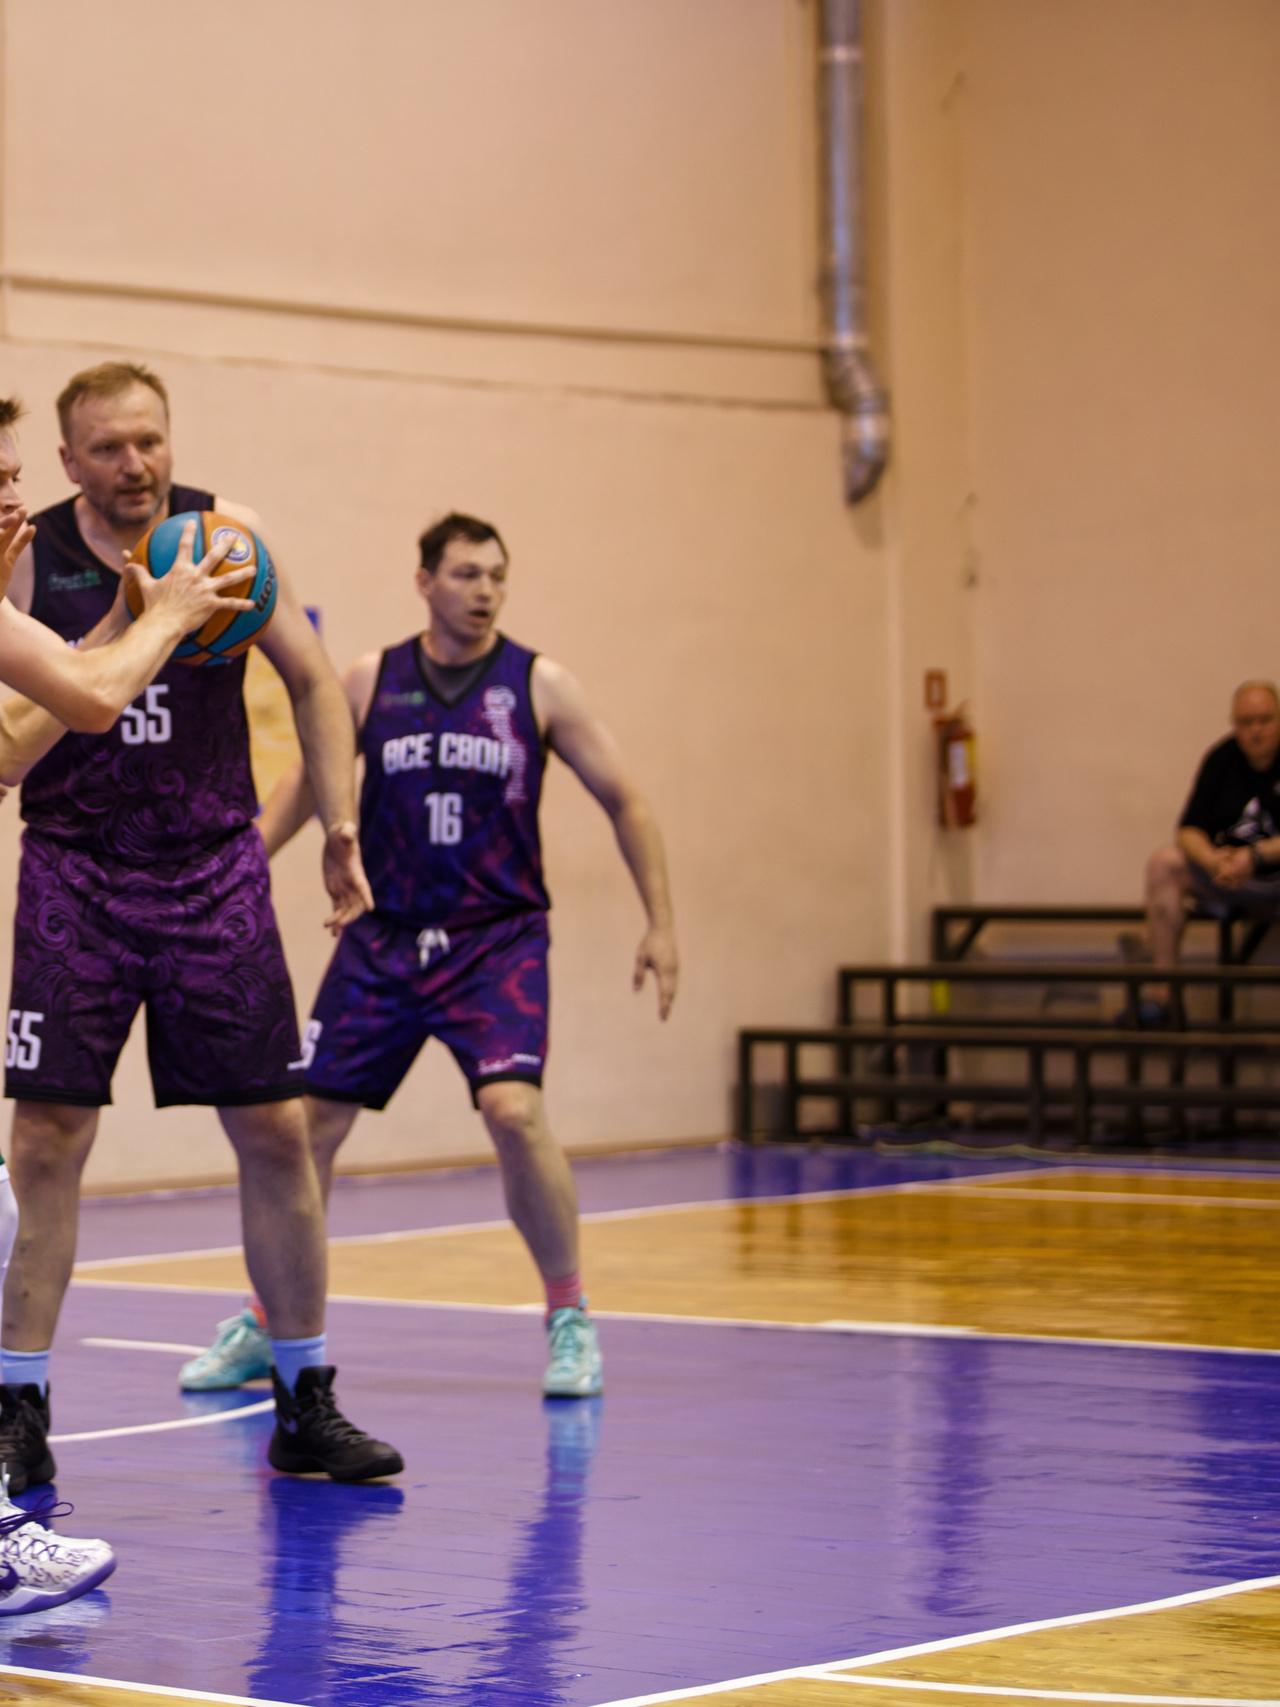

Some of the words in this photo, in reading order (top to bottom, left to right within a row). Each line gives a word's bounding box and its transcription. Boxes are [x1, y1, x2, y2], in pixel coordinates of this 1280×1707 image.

[121, 684, 172, 745] 55
[382, 732, 433, 775] ВСЕ
[425, 792, 463, 846] 16
[5, 1009, 44, 1070] 55
